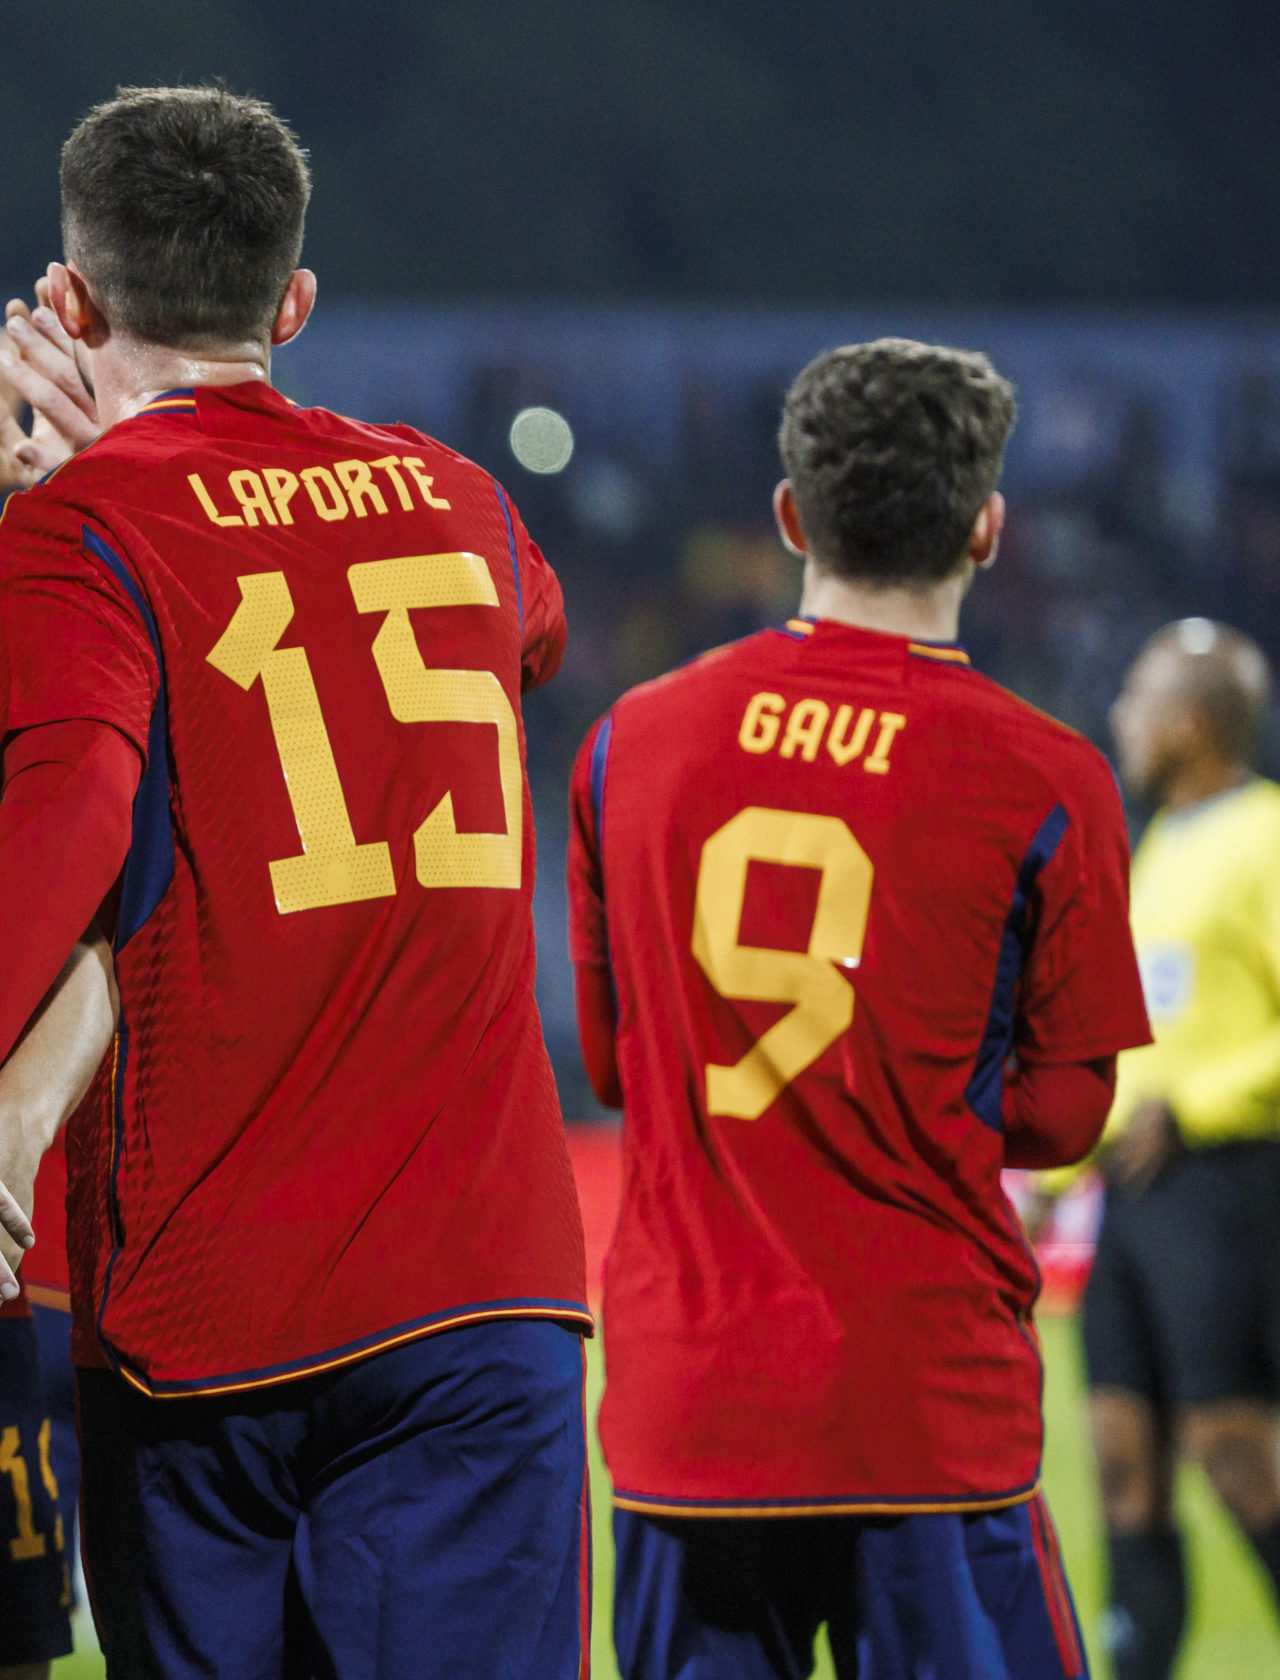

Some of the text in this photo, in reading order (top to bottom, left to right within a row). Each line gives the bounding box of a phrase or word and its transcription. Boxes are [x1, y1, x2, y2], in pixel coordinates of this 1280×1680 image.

[187, 455, 452, 527] LAPORTE
[205, 552, 523, 914] 15
[738, 692, 907, 775] GAVI
[691, 806, 875, 1121] 9
